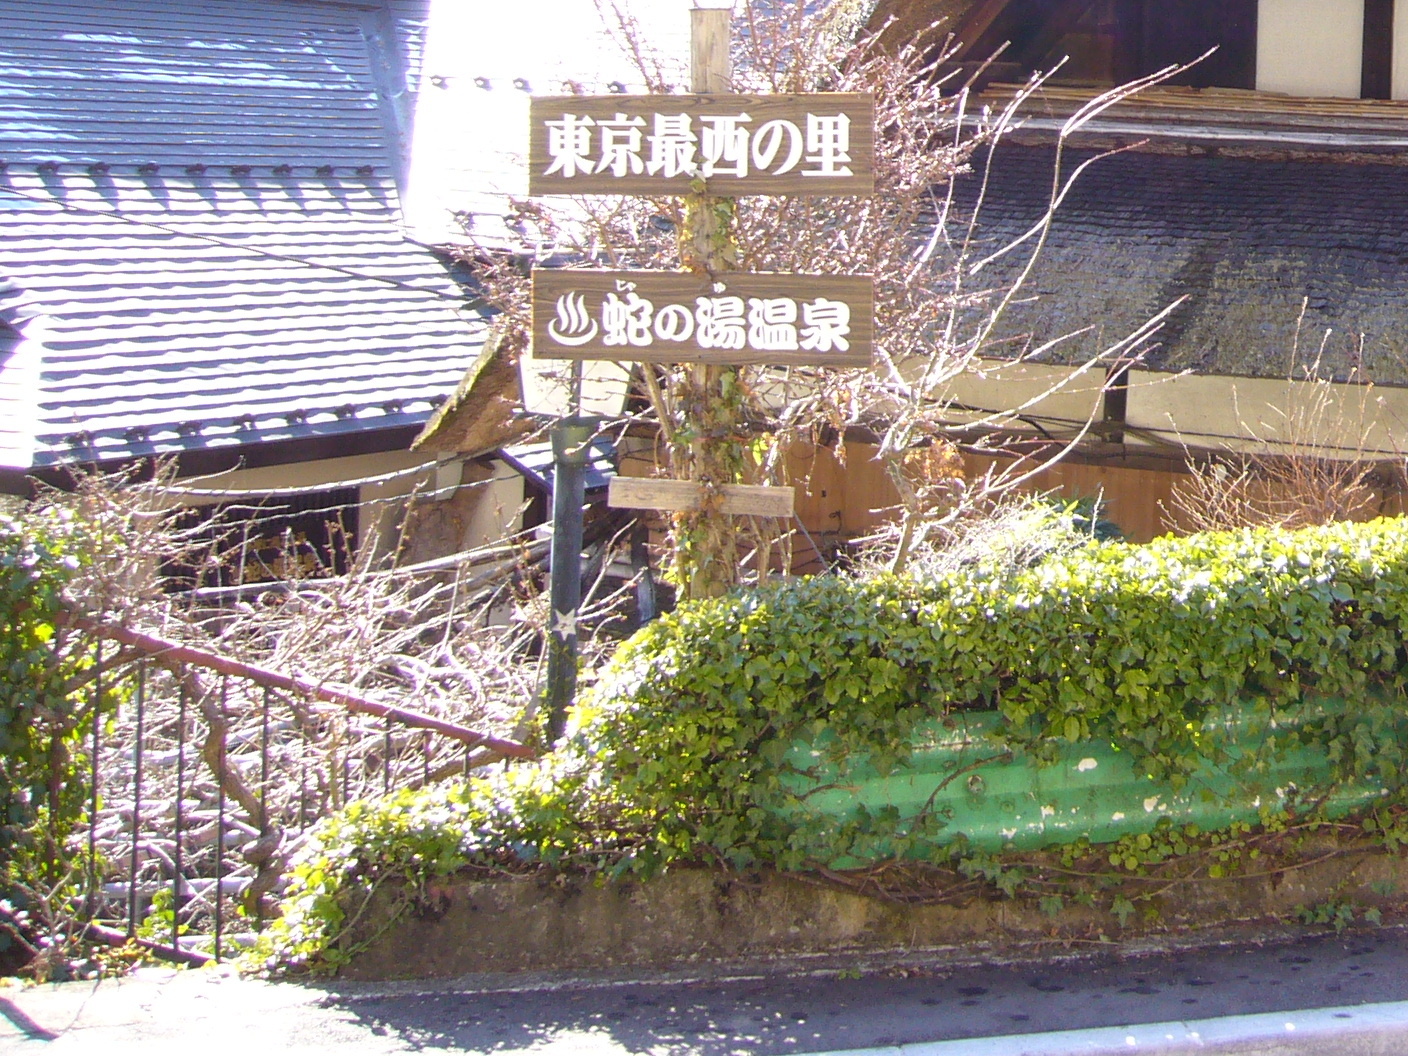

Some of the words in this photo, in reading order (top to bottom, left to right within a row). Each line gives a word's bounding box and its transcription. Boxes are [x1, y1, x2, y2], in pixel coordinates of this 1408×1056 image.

[544, 112, 854, 179] 東京最西の里
[602, 292, 850, 351] 蛇の湯温泉
